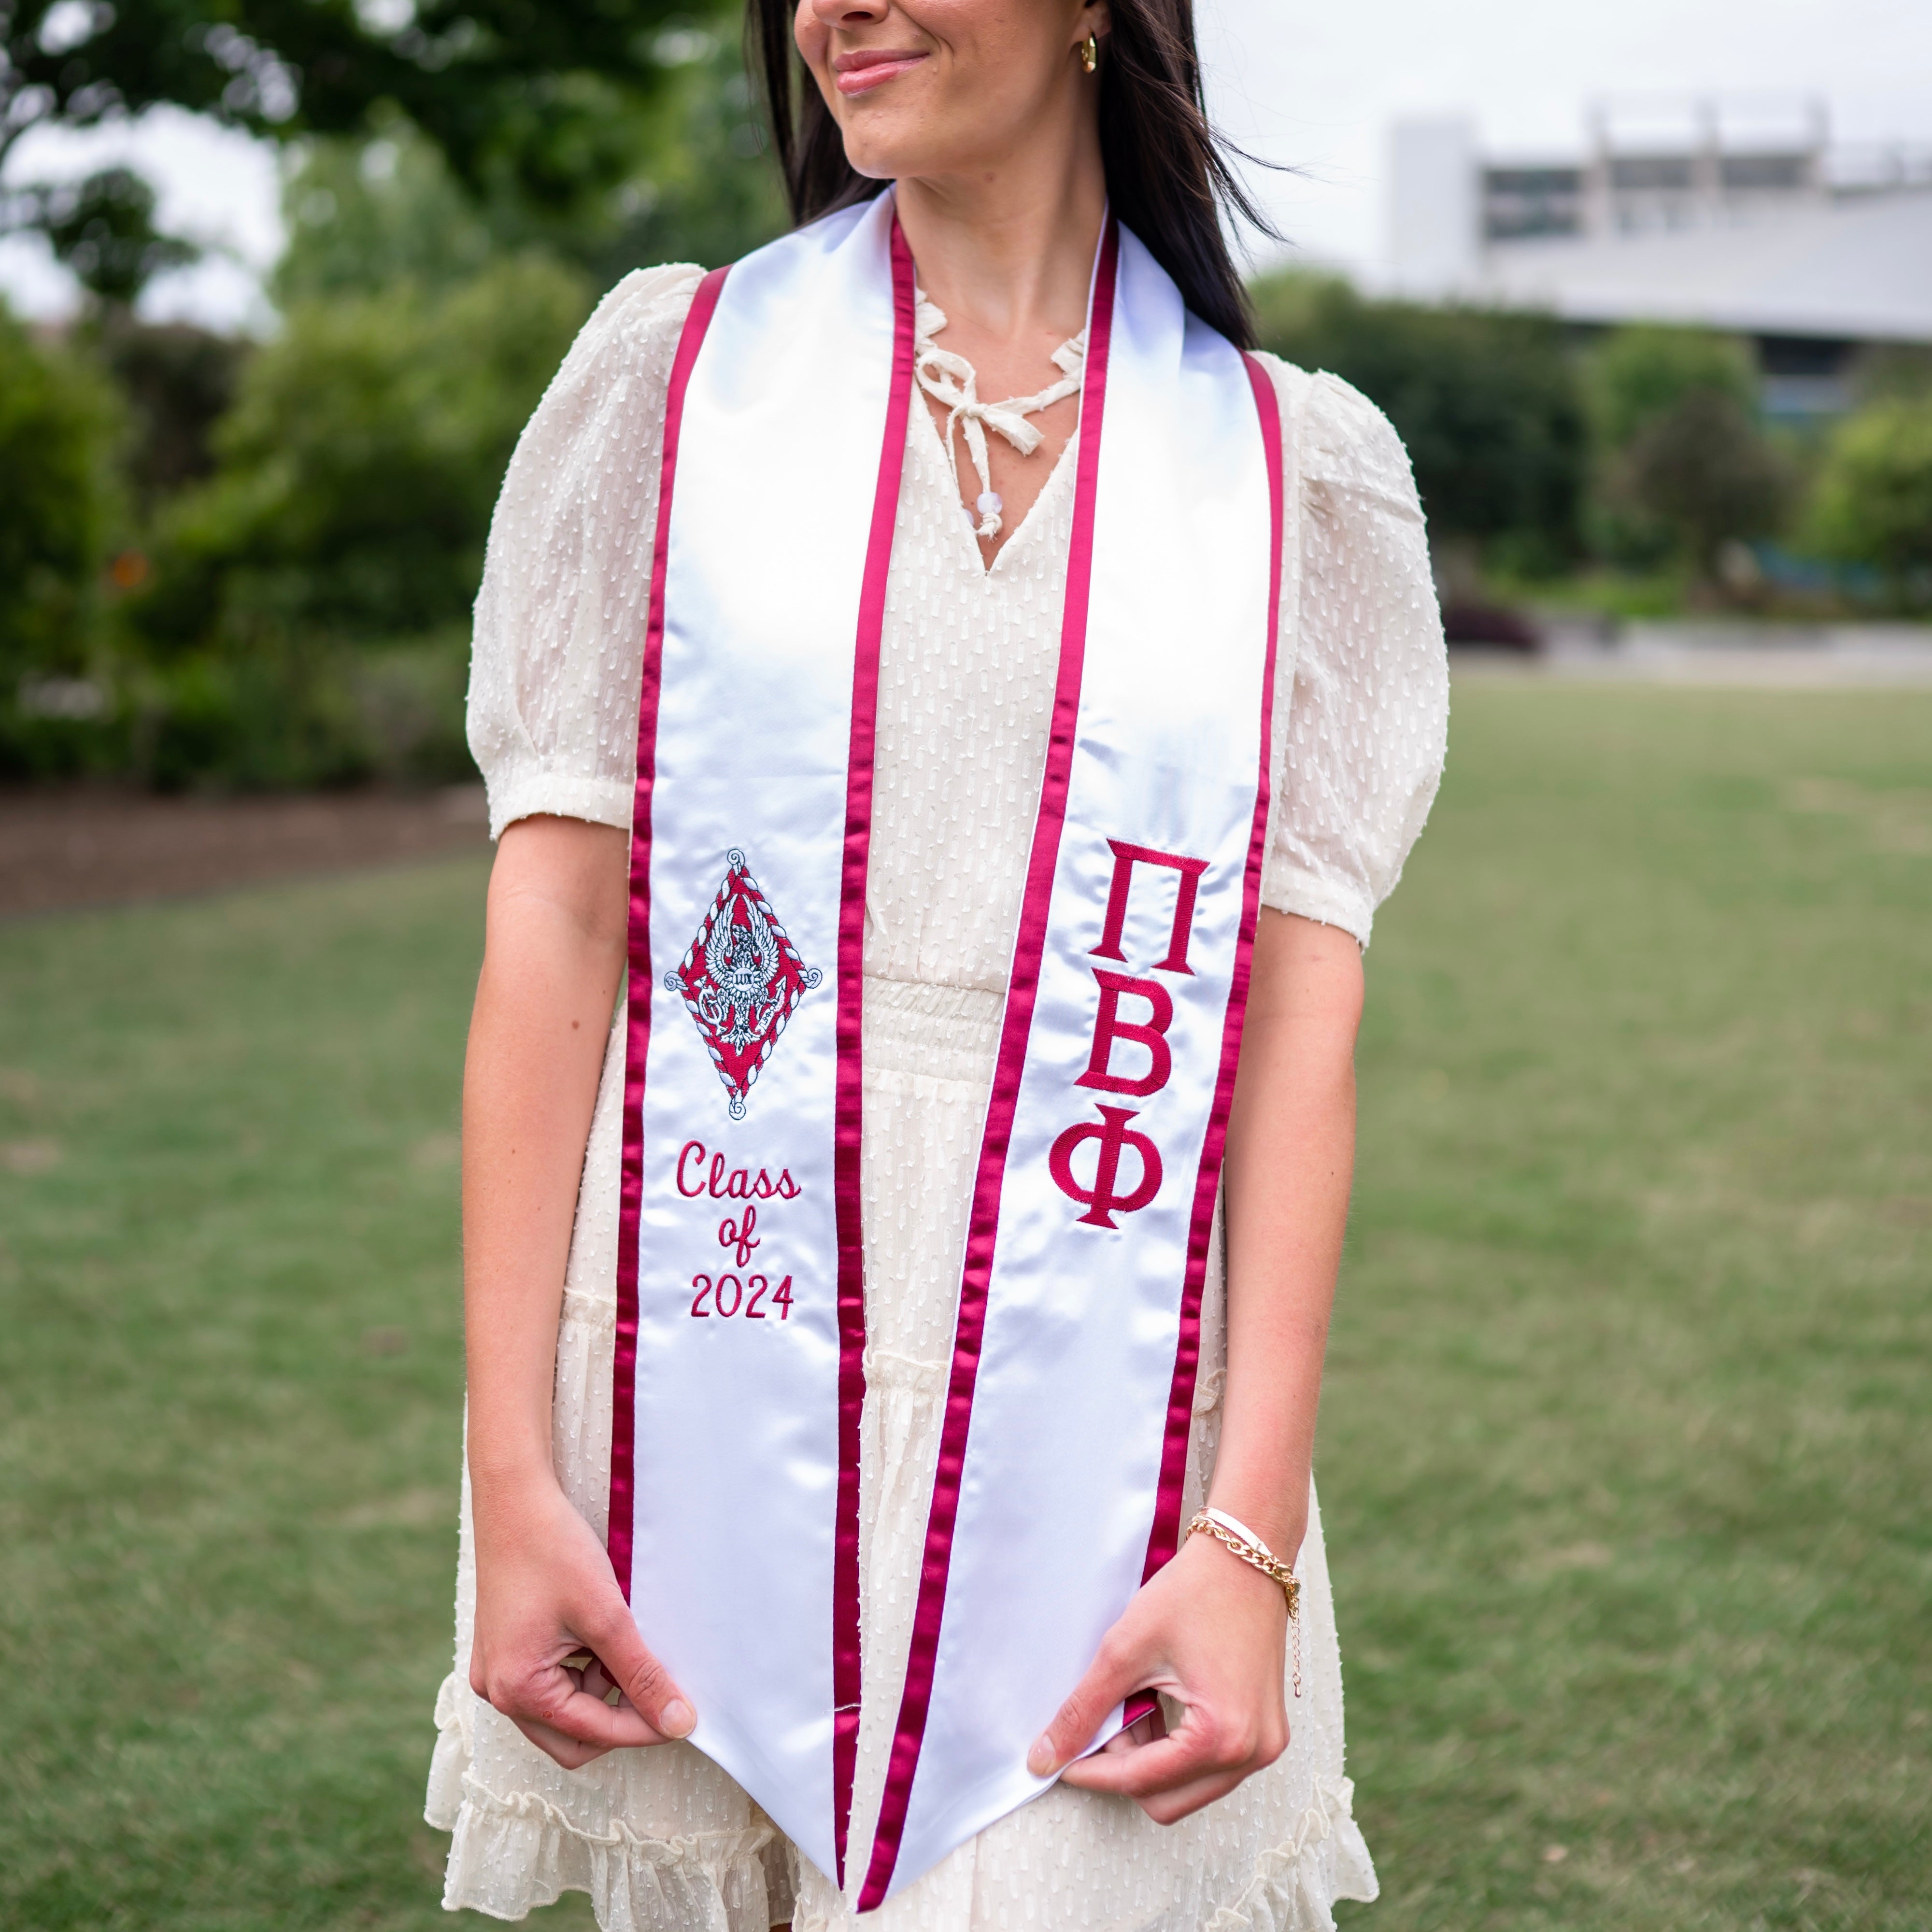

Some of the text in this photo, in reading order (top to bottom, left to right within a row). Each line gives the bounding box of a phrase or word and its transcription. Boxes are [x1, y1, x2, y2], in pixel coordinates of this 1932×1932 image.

[734, 973, 753, 985] LUX
[677, 1140, 802, 1199] Class
[719, 1204, 761, 1268] of
[691, 1273, 794, 1320] 2024
